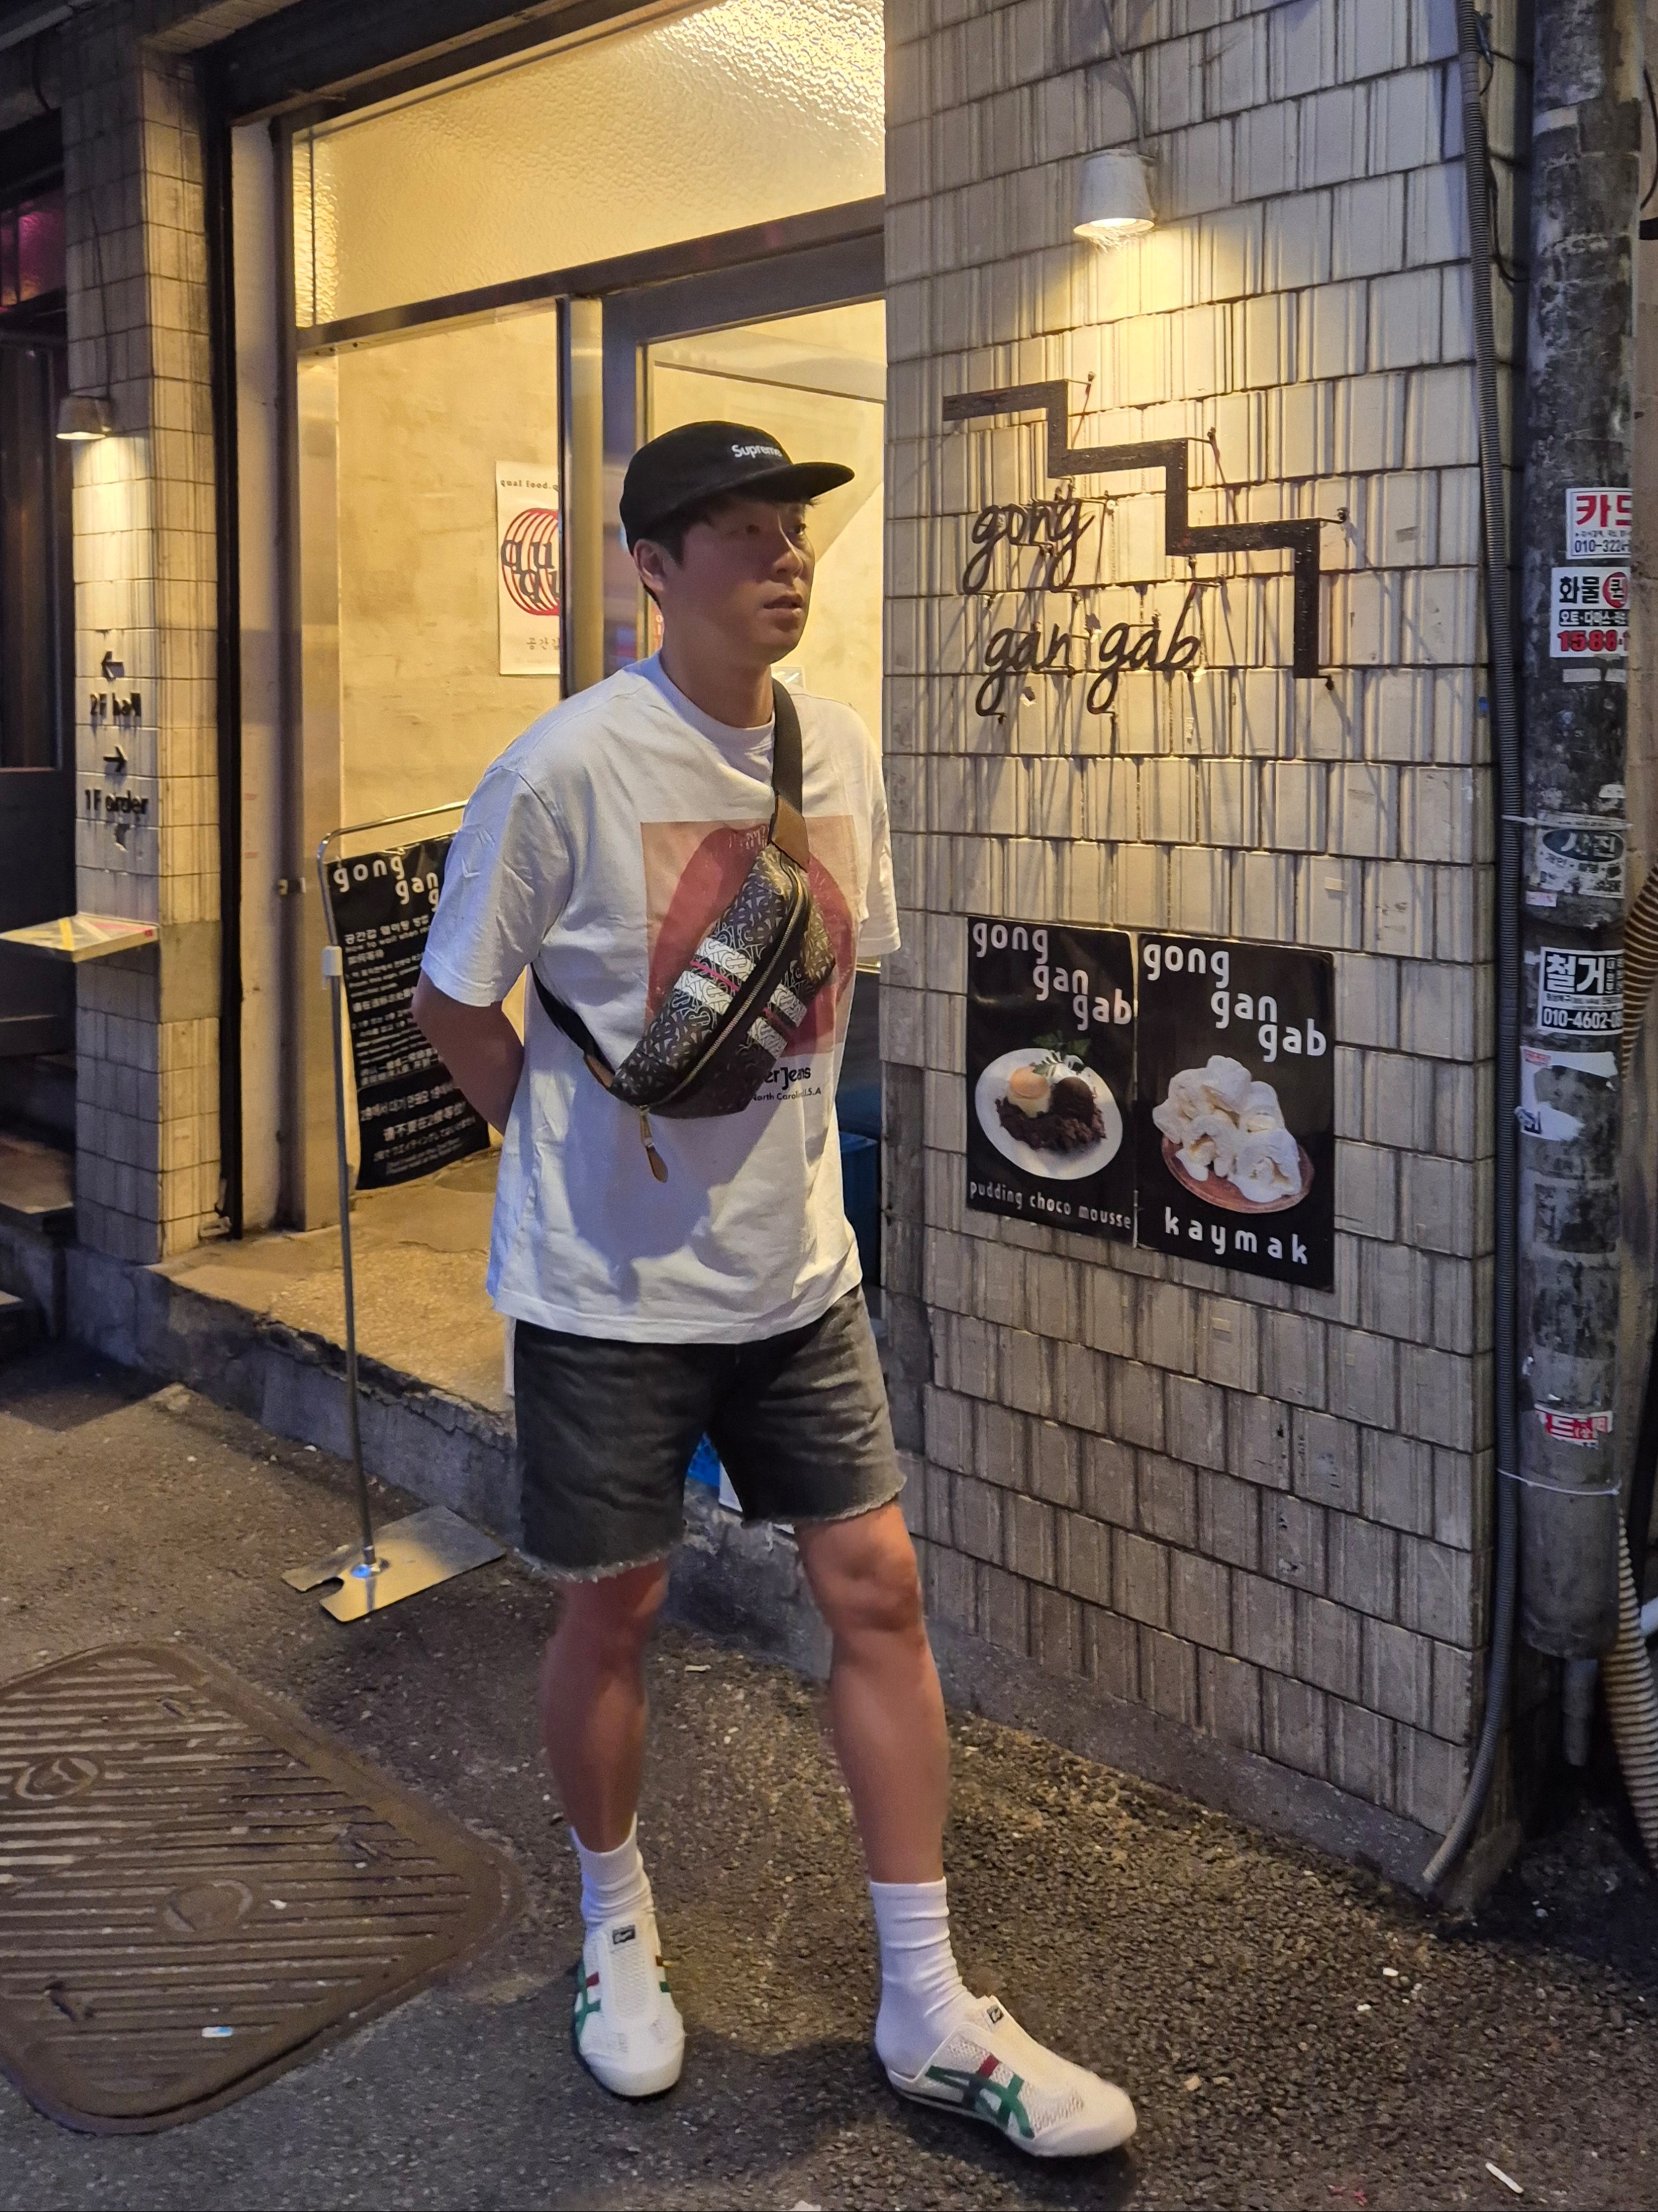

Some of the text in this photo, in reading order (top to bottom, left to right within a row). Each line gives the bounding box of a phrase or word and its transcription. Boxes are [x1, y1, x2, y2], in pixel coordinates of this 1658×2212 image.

[731, 444, 783, 458] Supreme
[963, 498, 1094, 594] gong
[1559, 576, 1599, 604] 화물
[976, 584, 1201, 716] gan gab
[333, 856, 405, 893] gong
[395, 872, 439, 905] gan
[972, 922, 1048, 965] gong
[1032, 965, 1089, 1001] gan
[1144, 943, 1230, 989] gong
[1546, 953, 1605, 994] 철거
[1072, 988, 1133, 1031] gab
[1210, 991, 1278, 1029] gan
[1258, 1017, 1327, 1063] gab
[970, 1181, 1132, 1229] pudding choco mousse
[1165, 1205, 1308, 1265] kaymak
